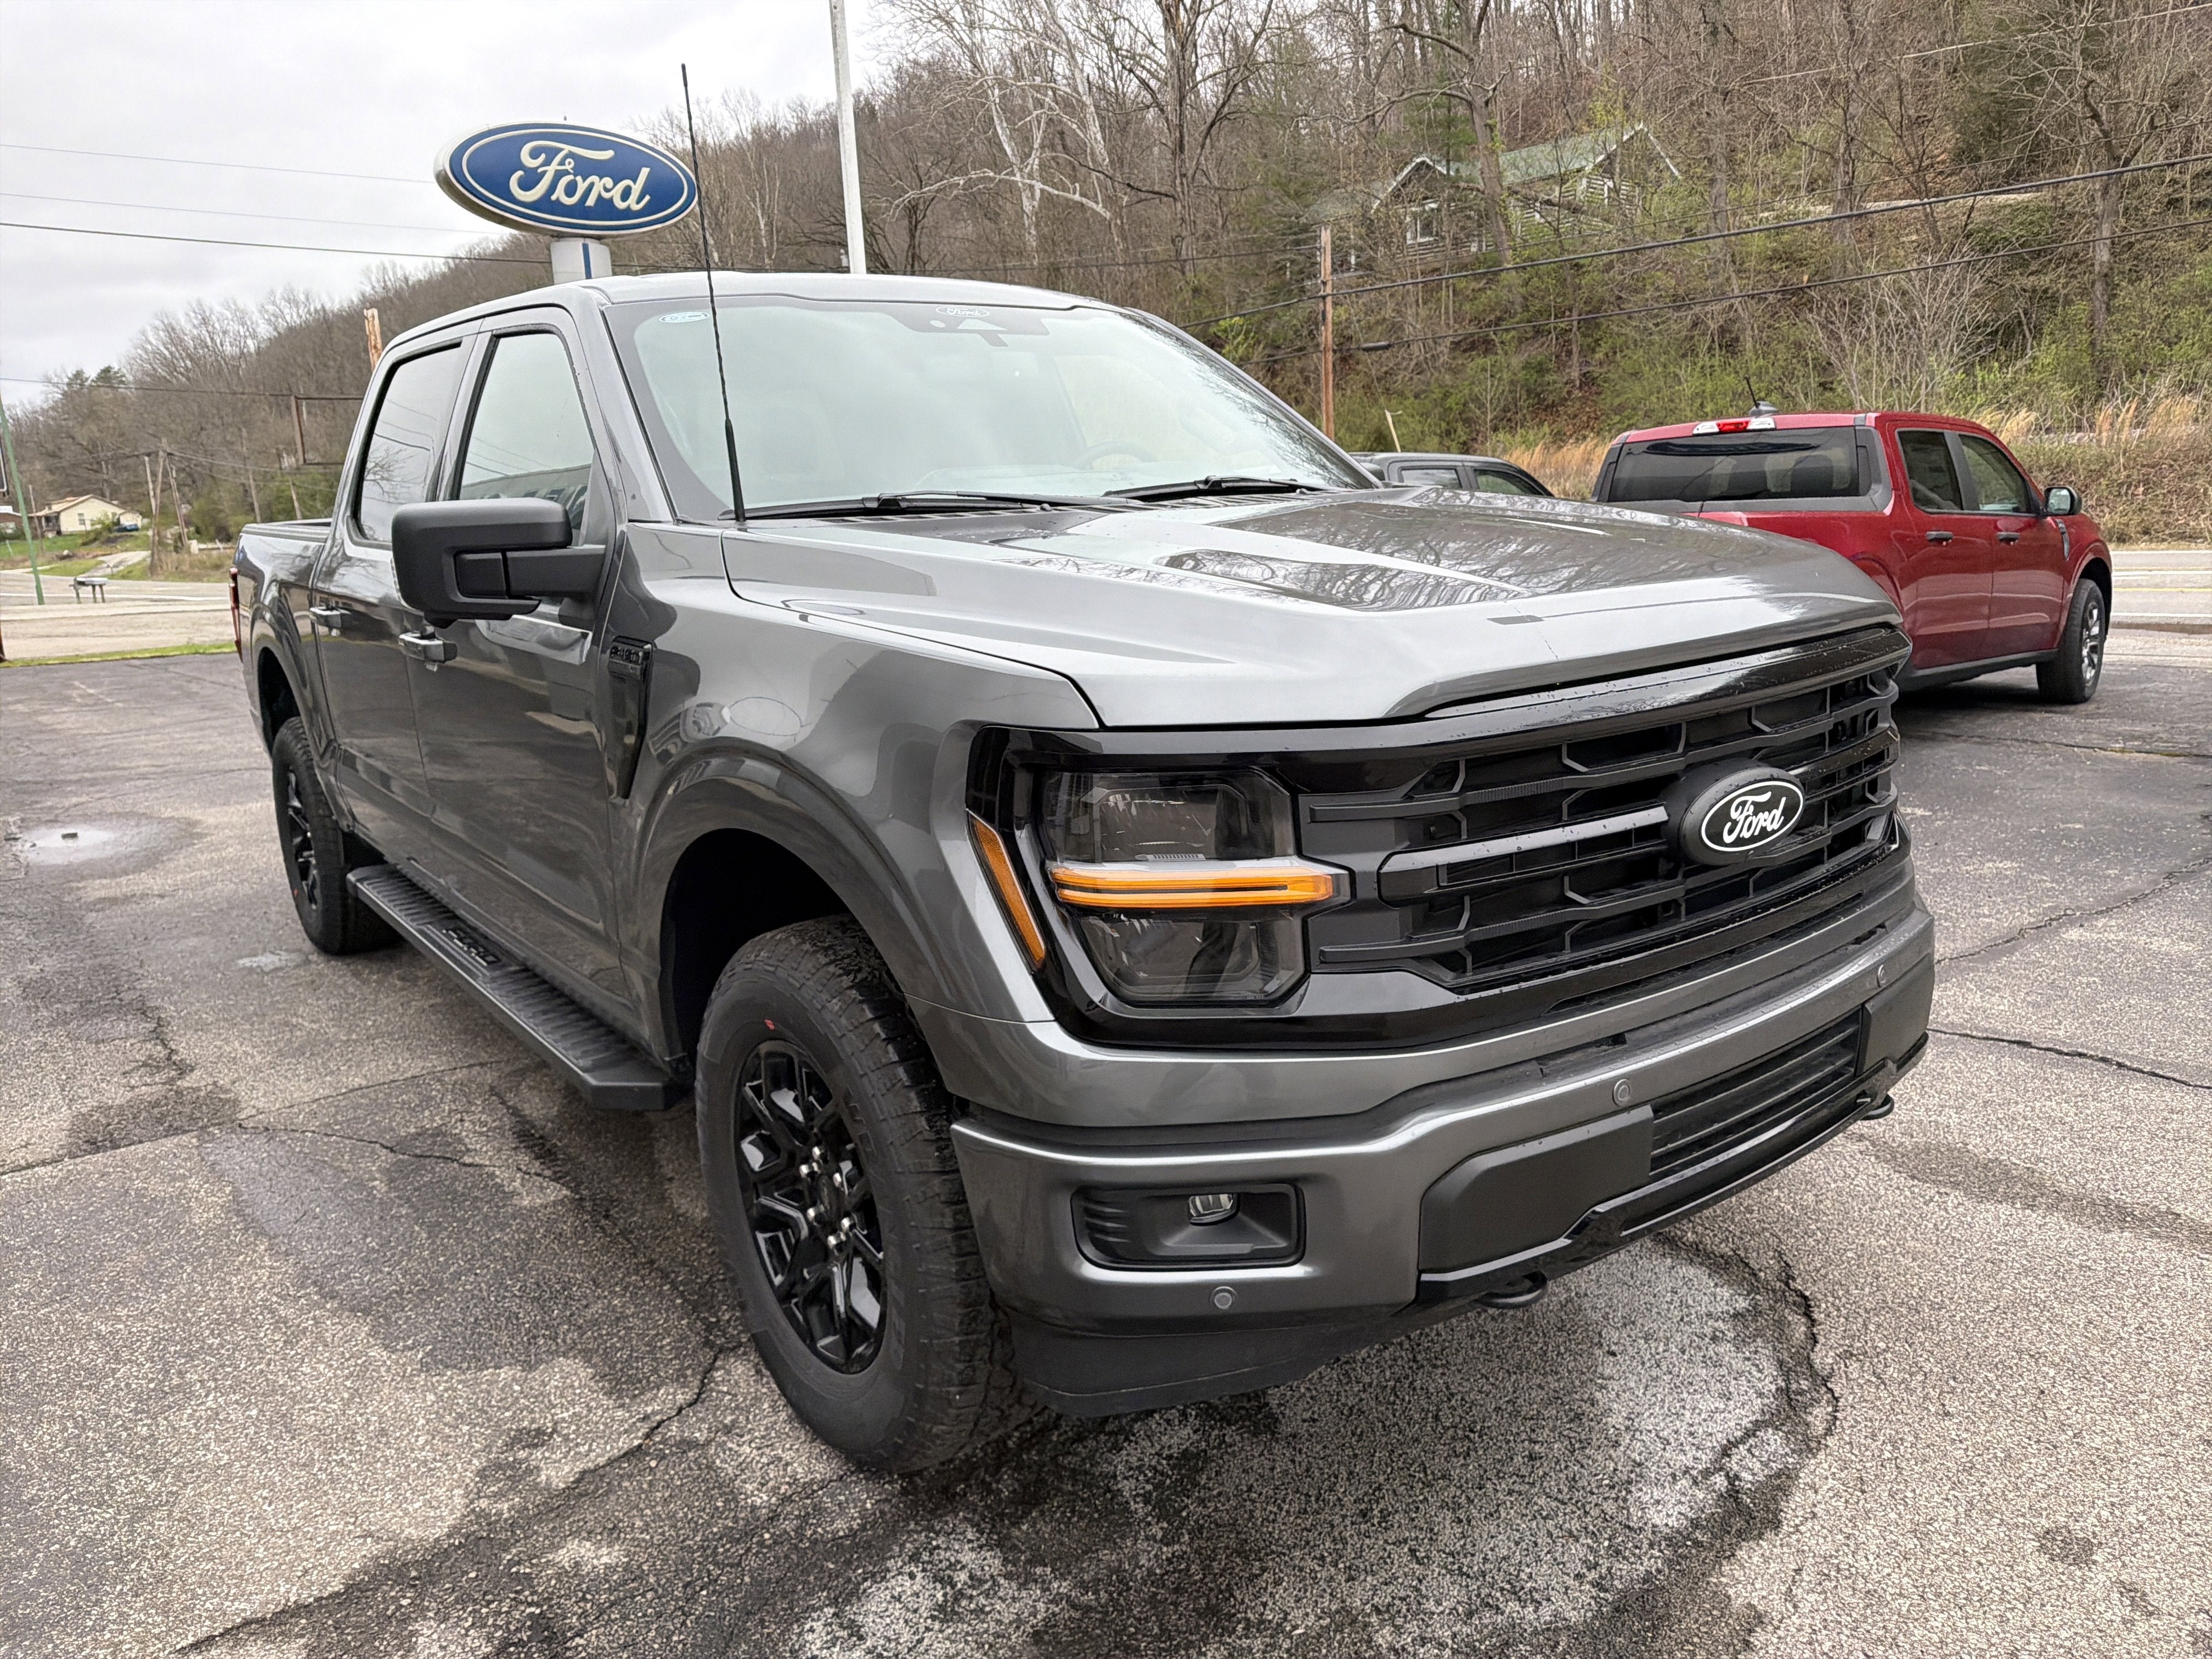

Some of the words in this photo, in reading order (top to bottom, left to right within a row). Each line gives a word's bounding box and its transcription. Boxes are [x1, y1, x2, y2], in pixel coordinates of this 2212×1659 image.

[509, 140, 651, 211] Ford
[946, 307, 981, 316] Ford
[1723, 791, 1786, 844] Ford
